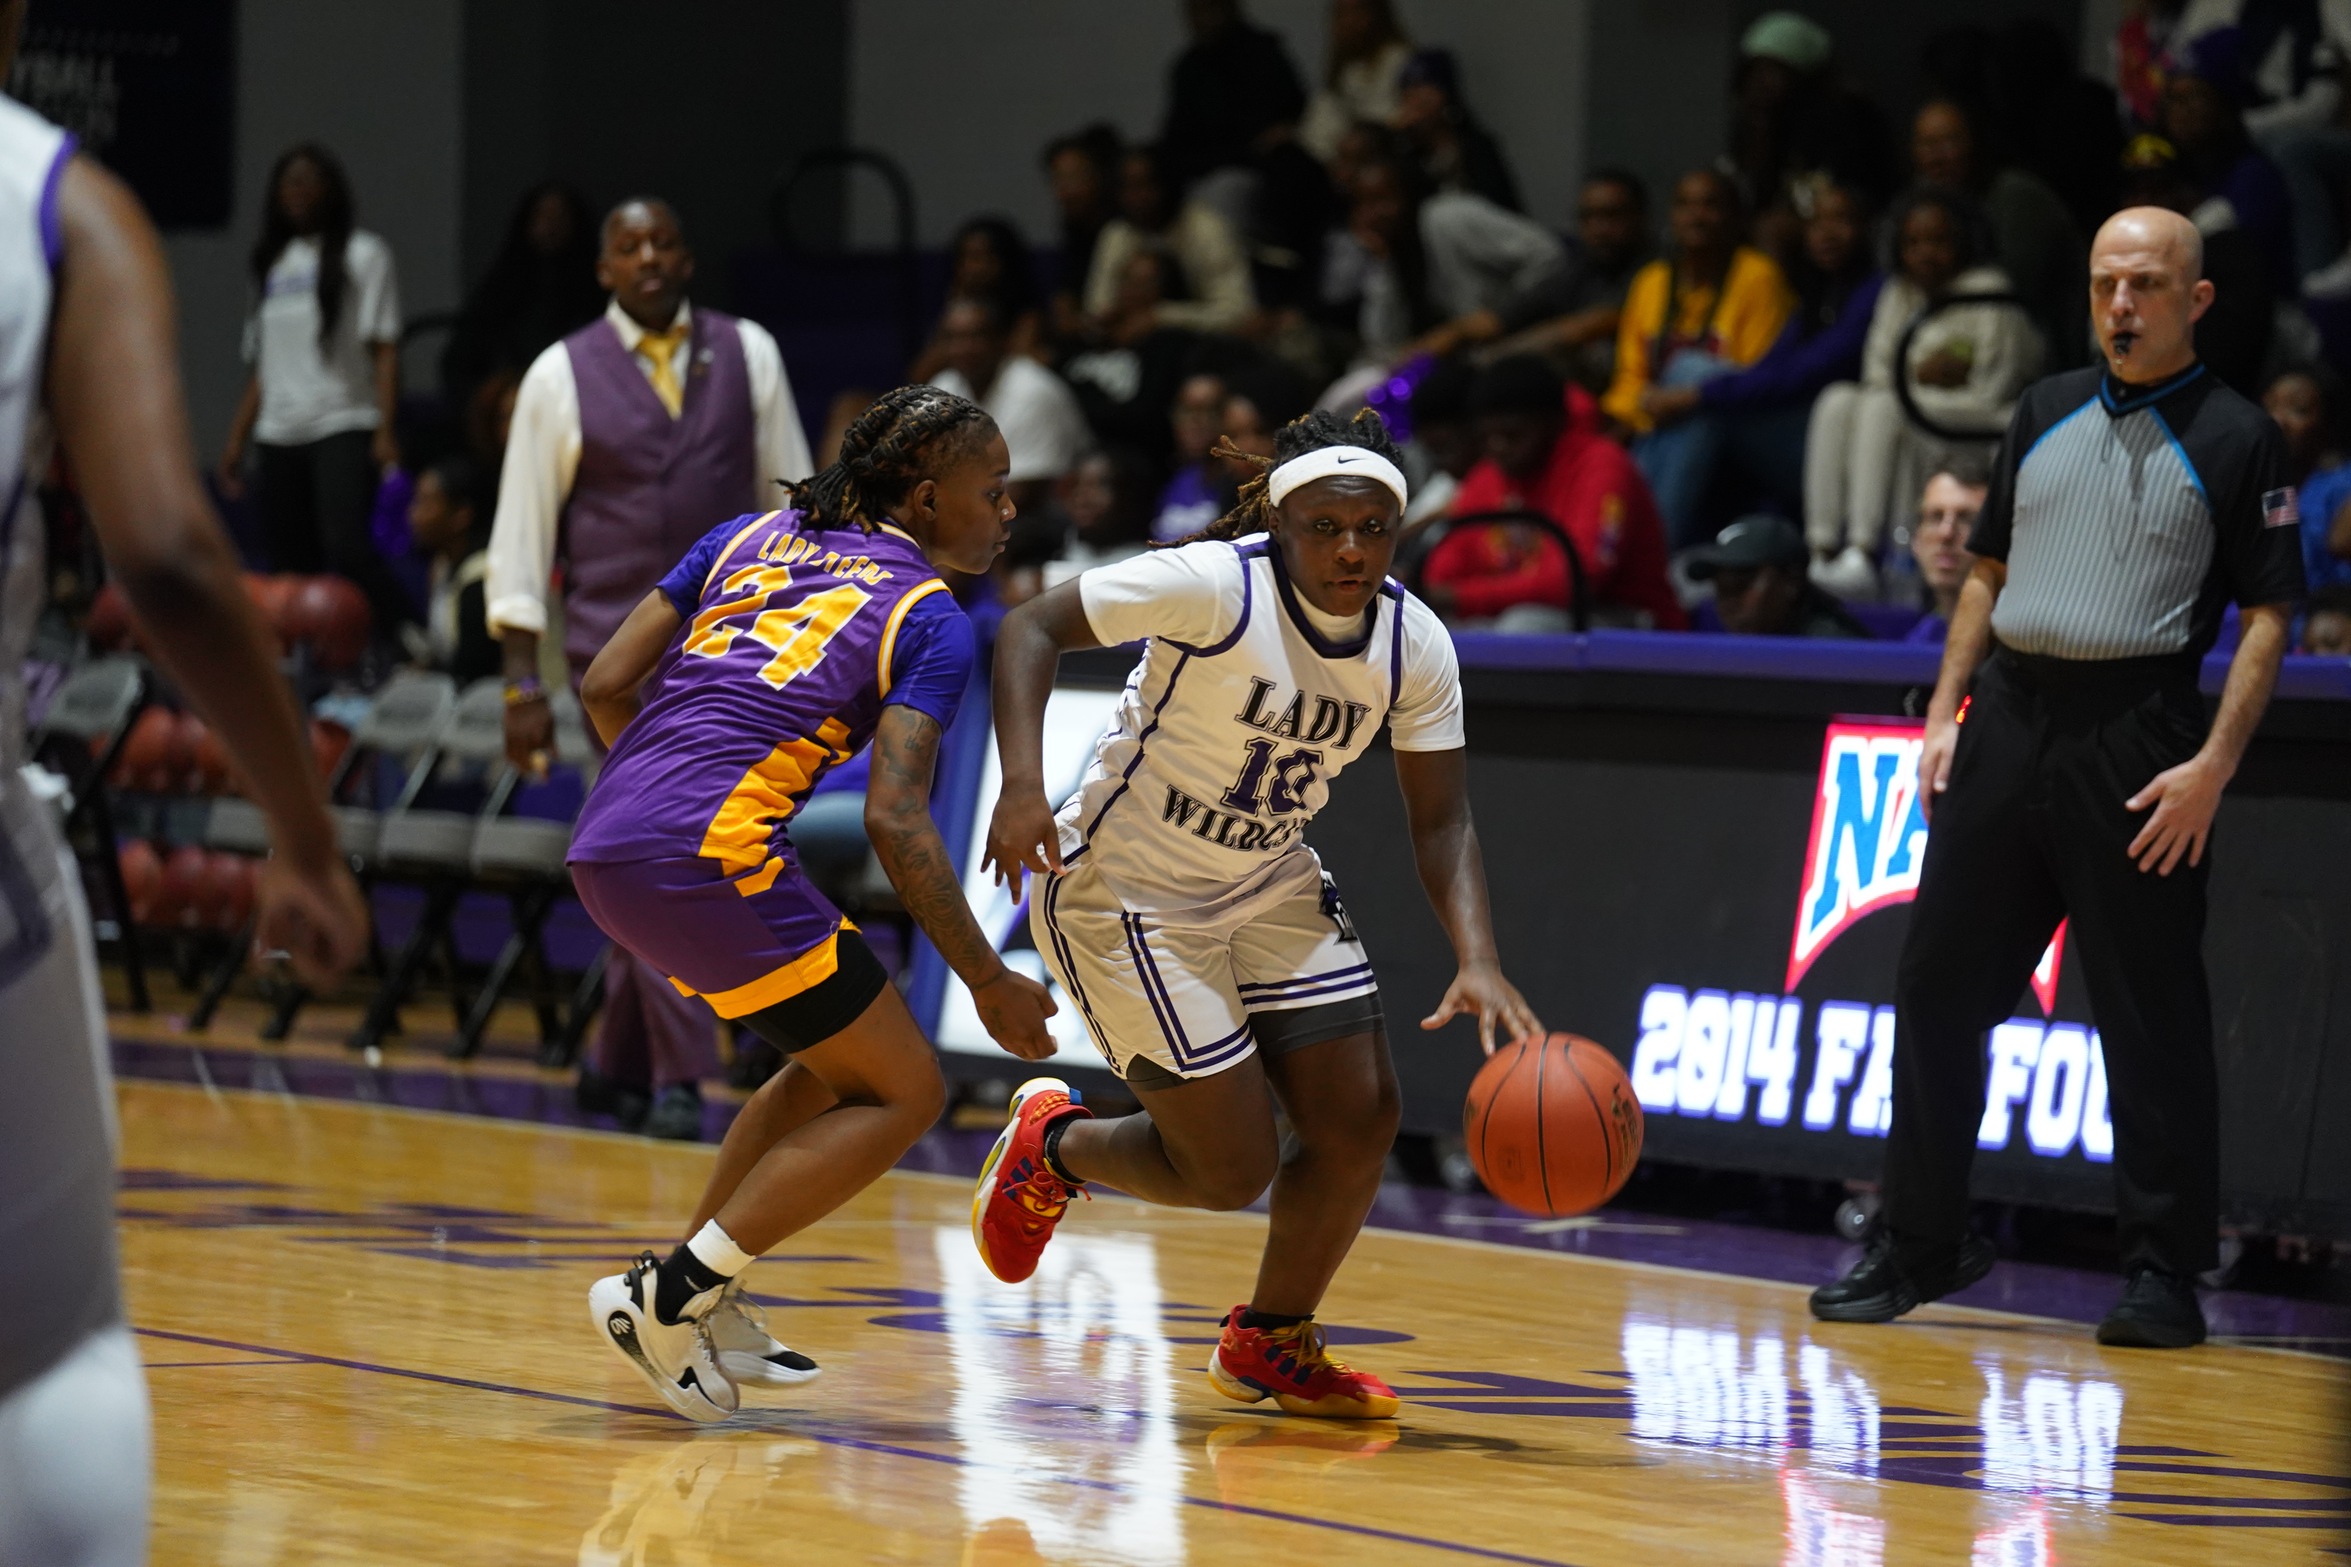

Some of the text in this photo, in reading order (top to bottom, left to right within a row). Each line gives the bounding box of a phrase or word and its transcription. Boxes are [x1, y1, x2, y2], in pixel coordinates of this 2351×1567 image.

[756, 530, 822, 566] LADY
[682, 562, 873, 692] 24
[1234, 674, 1373, 751] LADY
[1219, 735, 1325, 817] 10
[1632, 982, 1802, 1129] 2014
[1802, 999, 1896, 1139] FA
